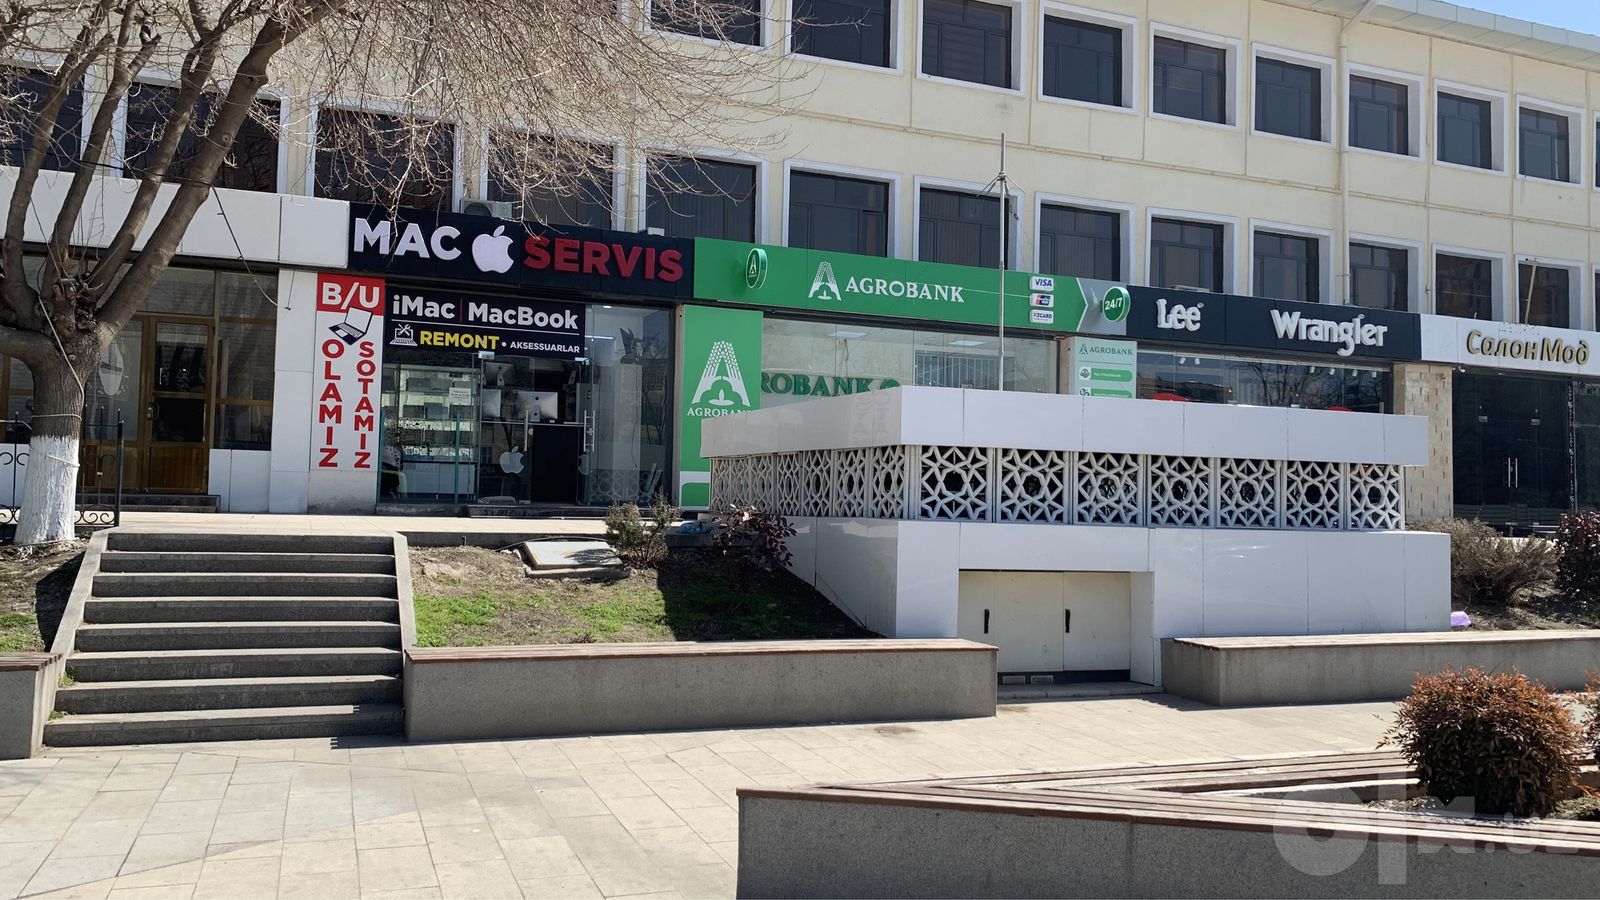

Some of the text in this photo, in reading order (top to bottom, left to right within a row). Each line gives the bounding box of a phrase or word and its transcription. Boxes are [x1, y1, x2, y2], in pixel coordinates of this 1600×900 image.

[353, 217, 684, 283] MAC SERVIS
[322, 282, 380, 310] B/U
[845, 276, 965, 303] AGROBANK
[1034, 278, 1053, 288] VISA
[393, 294, 579, 330] iMac MacBook
[1104, 298, 1123, 311] 24/7
[1156, 298, 1201, 332] Lee
[420, 330, 580, 353] REMONT AKSESSUARLAR
[1270, 309, 1388, 357] Wrangler
[1090, 346, 1133, 356] AGROBANK
[318, 338, 346, 468] OLAMIZ
[353, 340, 376, 469] SOTAMIZ
[686, 407, 752, 417] AGROBA
